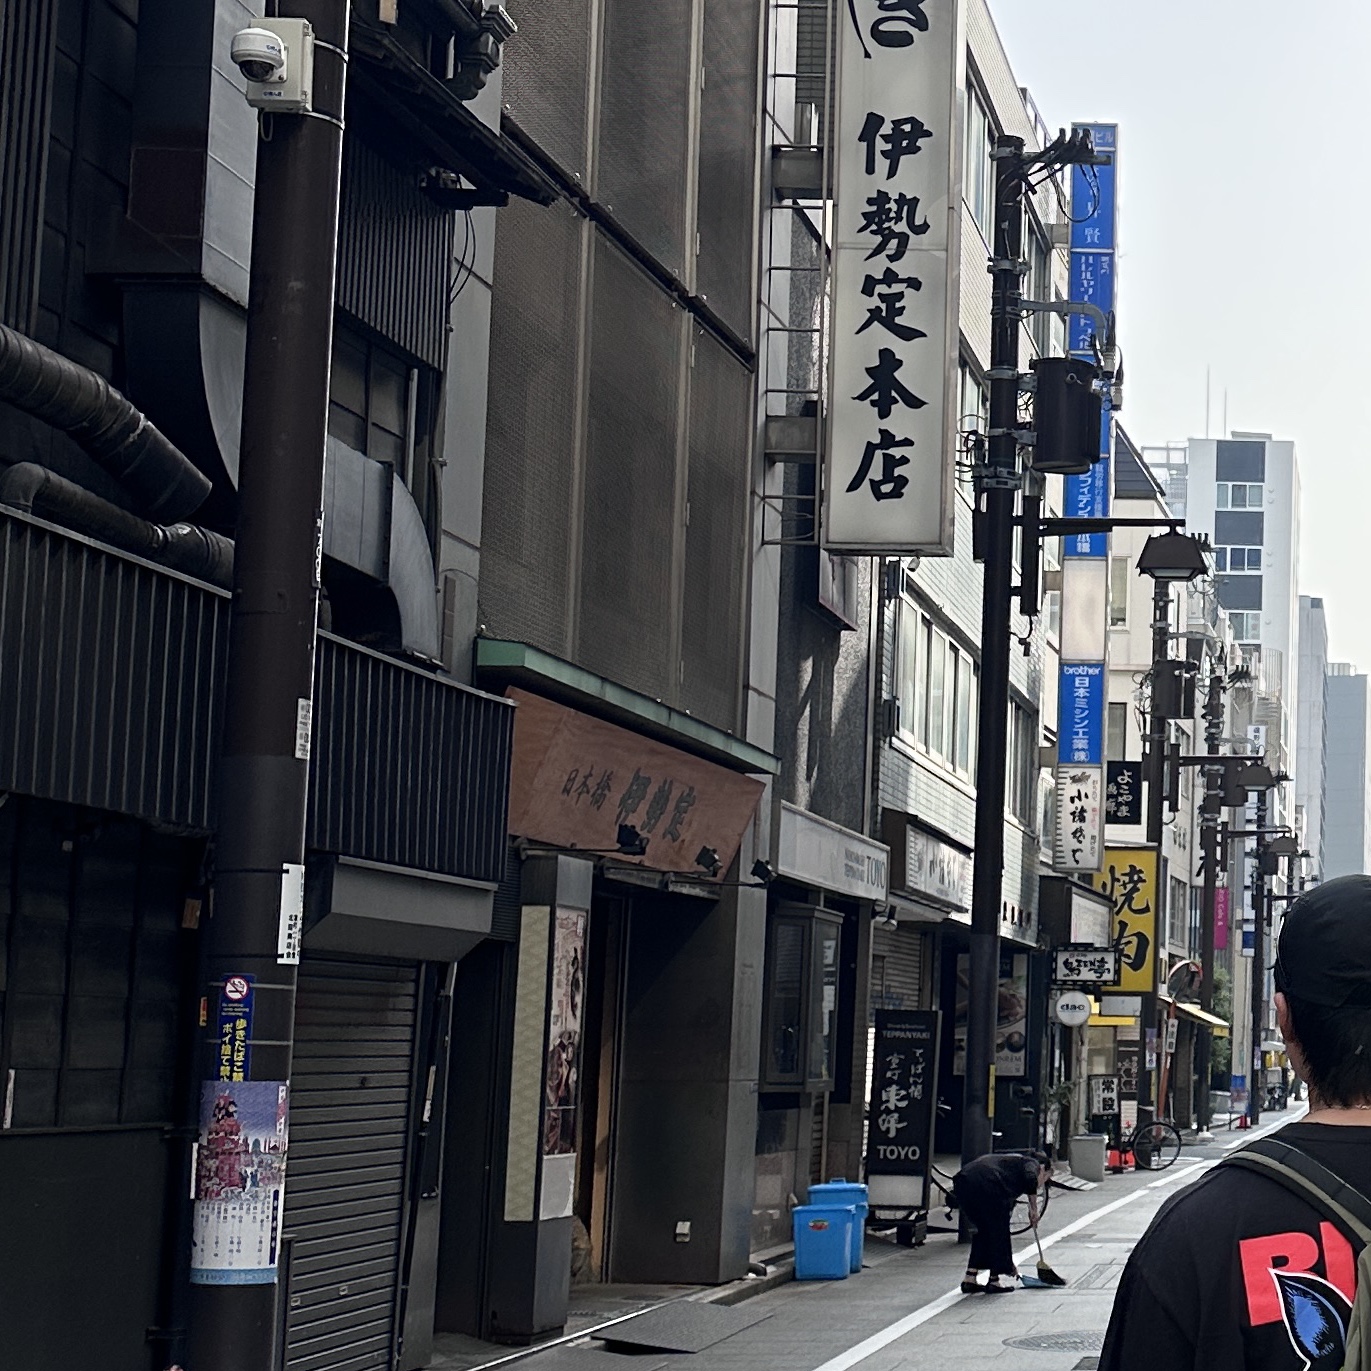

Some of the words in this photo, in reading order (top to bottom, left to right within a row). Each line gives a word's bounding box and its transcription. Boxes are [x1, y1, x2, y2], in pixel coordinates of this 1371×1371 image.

[846, 111, 933, 502] 伊勢定本店
[1064, 665, 1101, 675] brother
[1117, 769, 1133, 817] よこやま
[1102, 864, 1151, 972] 焼肉
[882, 1030, 930, 1040] TEPPANYAKI
[877, 1145, 920, 1160] TOYO
